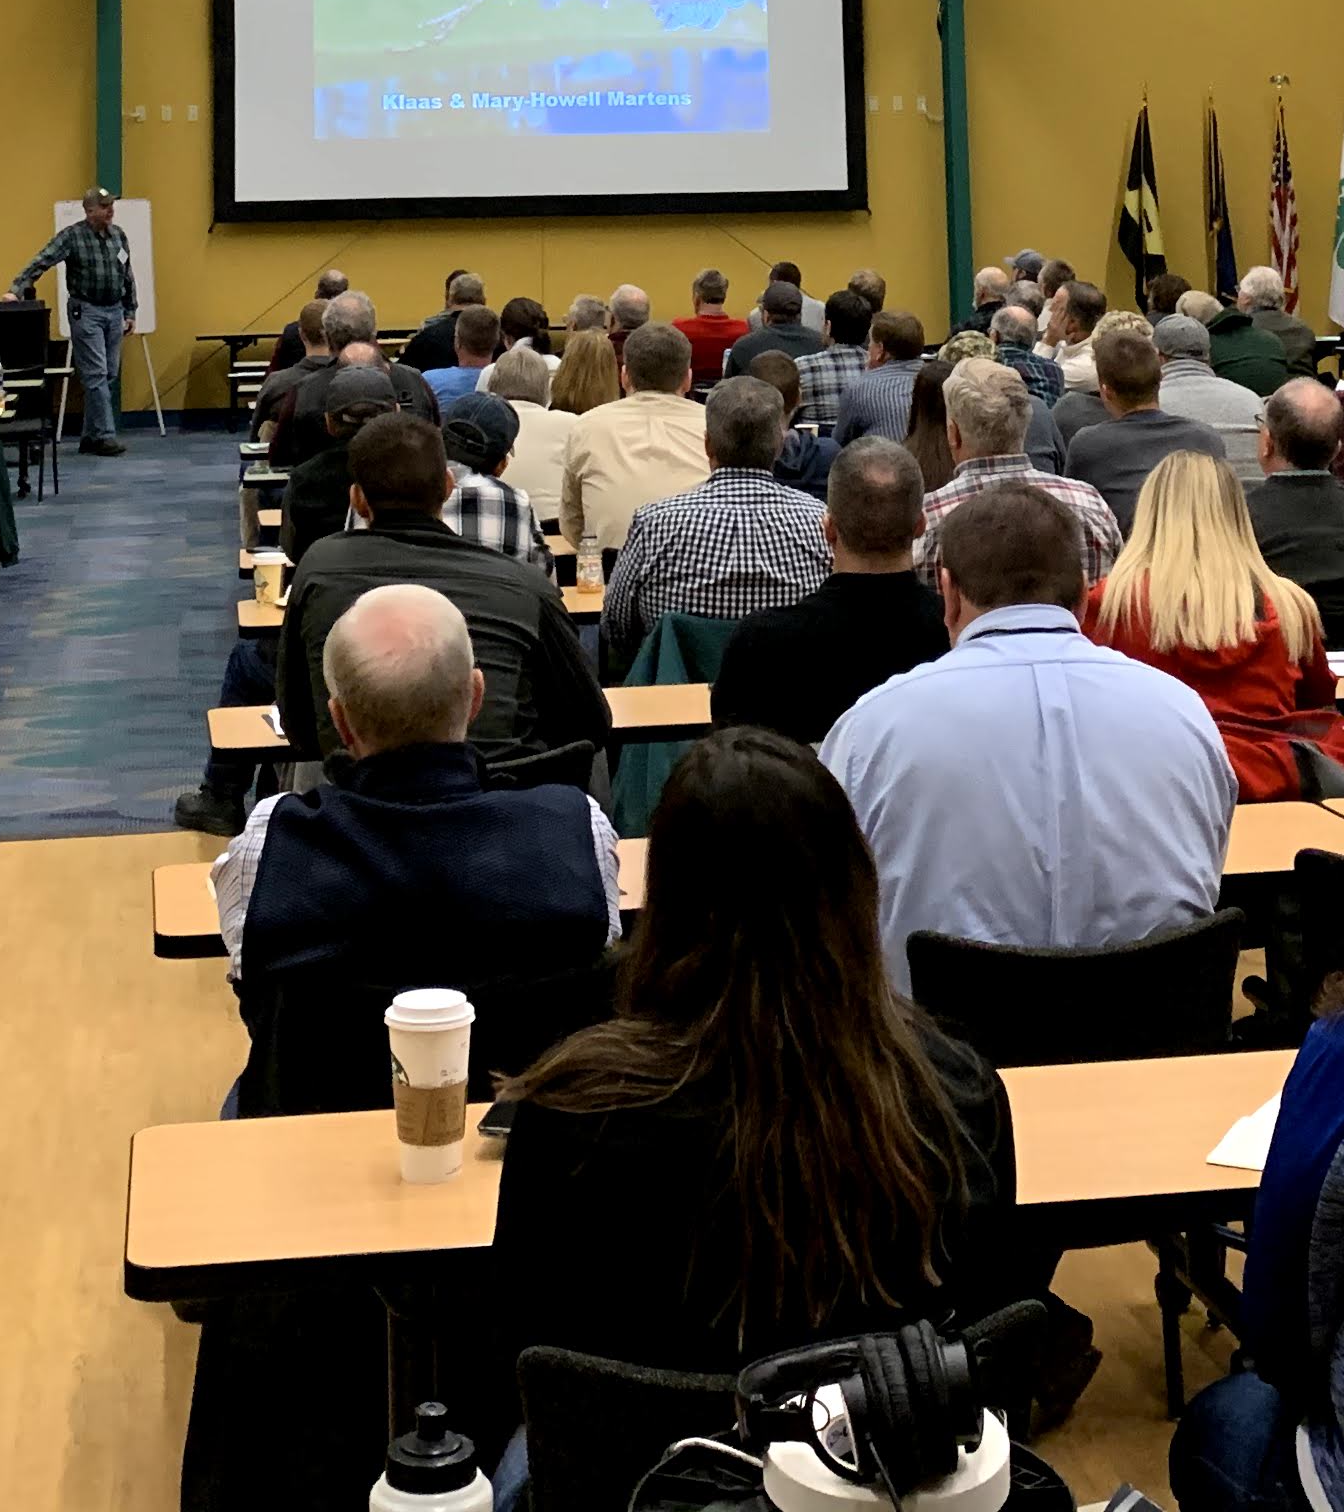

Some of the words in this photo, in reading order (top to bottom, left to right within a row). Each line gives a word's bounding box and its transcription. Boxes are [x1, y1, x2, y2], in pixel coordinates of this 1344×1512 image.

[383, 93, 443, 110] Klaas
[450, 93, 465, 109] &
[472, 91, 601, 112] Mary-Howell
[607, 90, 693, 107] Martens
